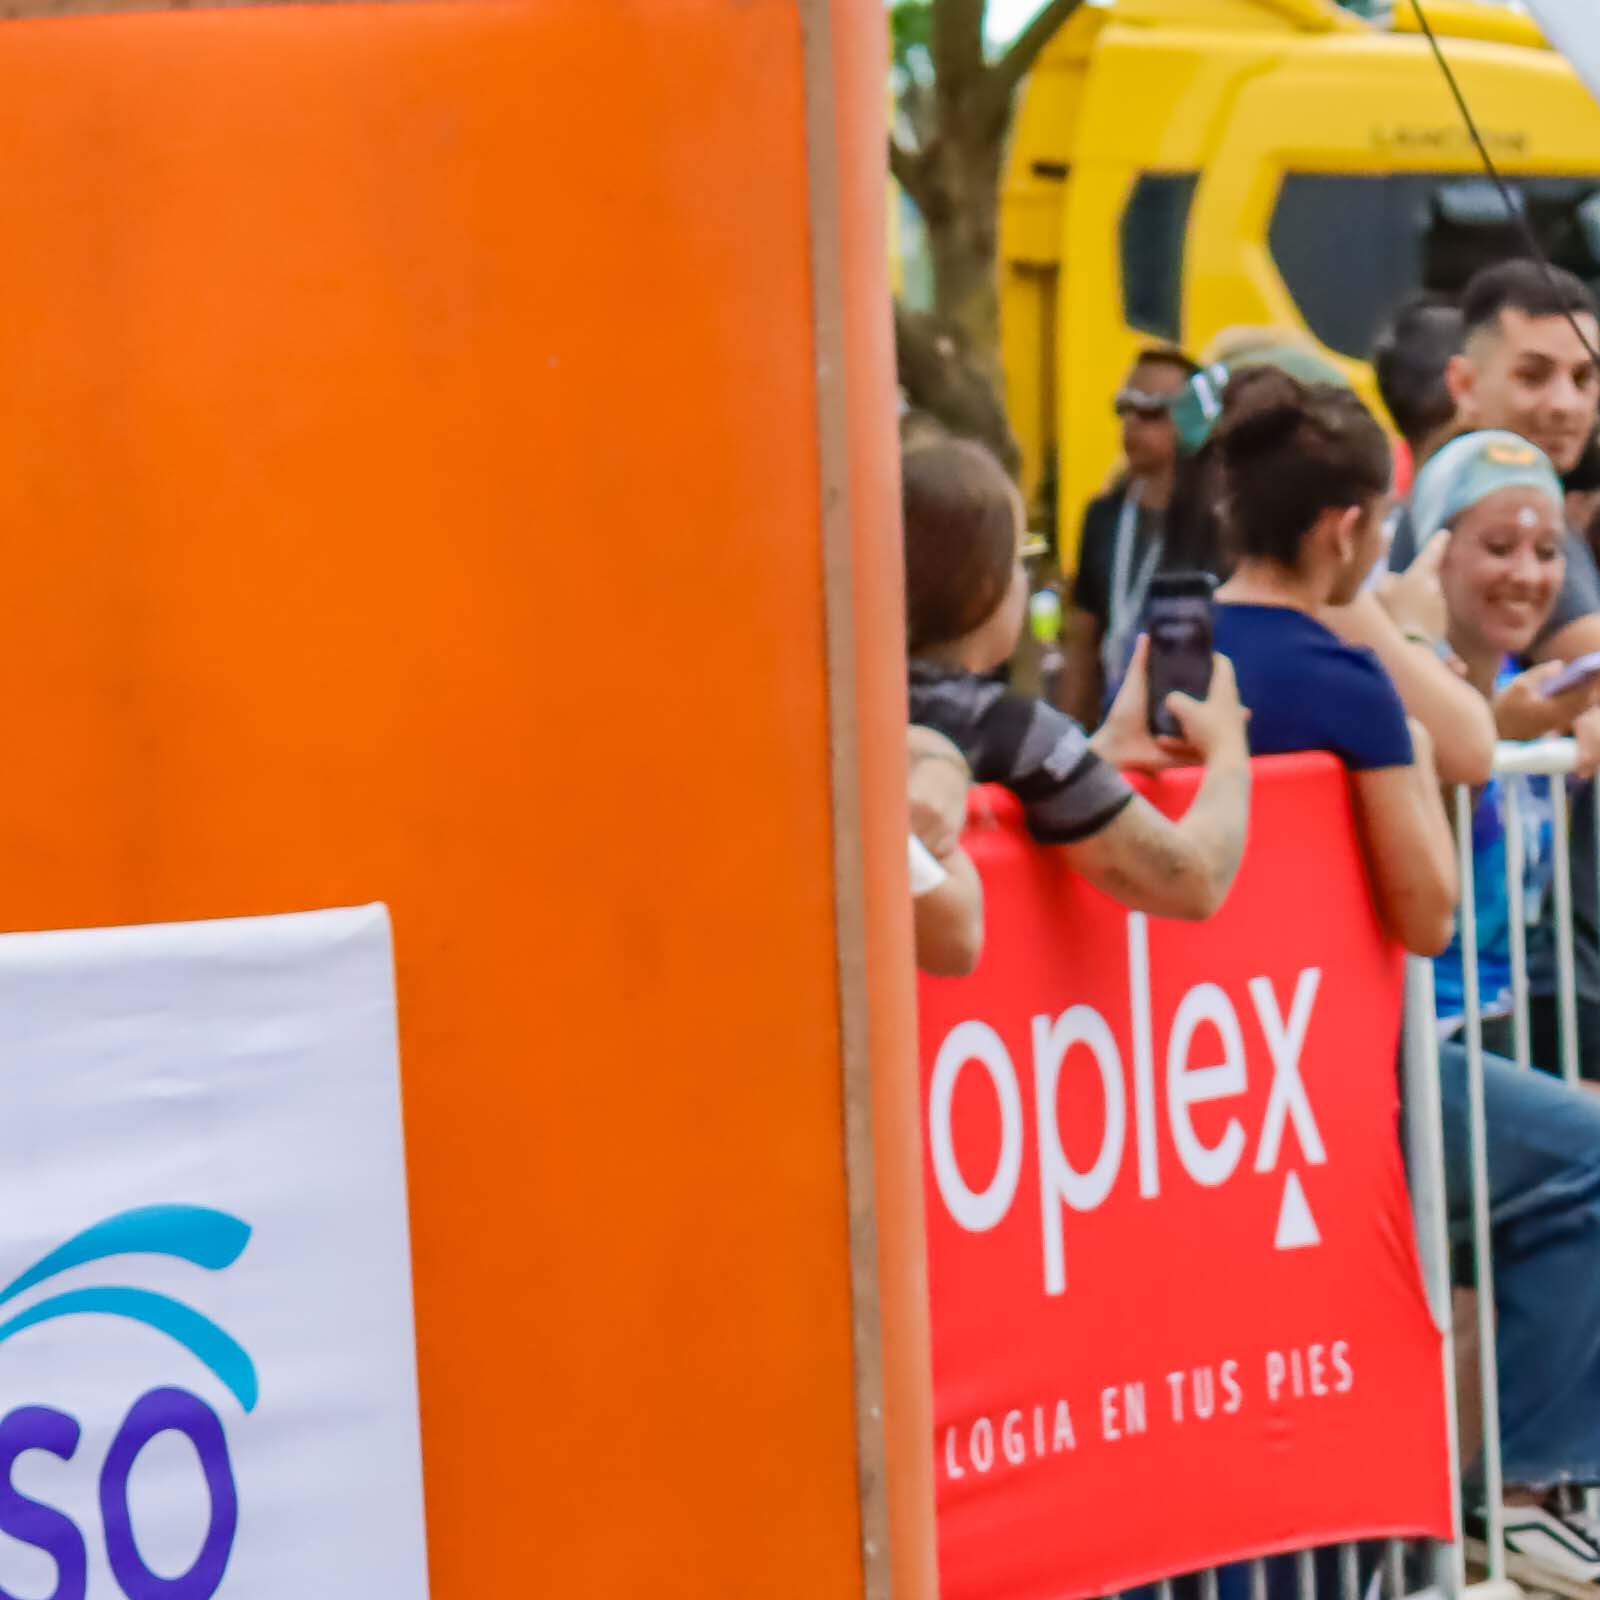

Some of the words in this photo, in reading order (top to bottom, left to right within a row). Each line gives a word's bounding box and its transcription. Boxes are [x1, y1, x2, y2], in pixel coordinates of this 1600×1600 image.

[945, 1400, 1076, 1479] LOGIA
[1101, 1381, 1147, 1441] EN
[1166, 1359, 1242, 1423] TUS
[1265, 1339, 1354, 1401] PIES
